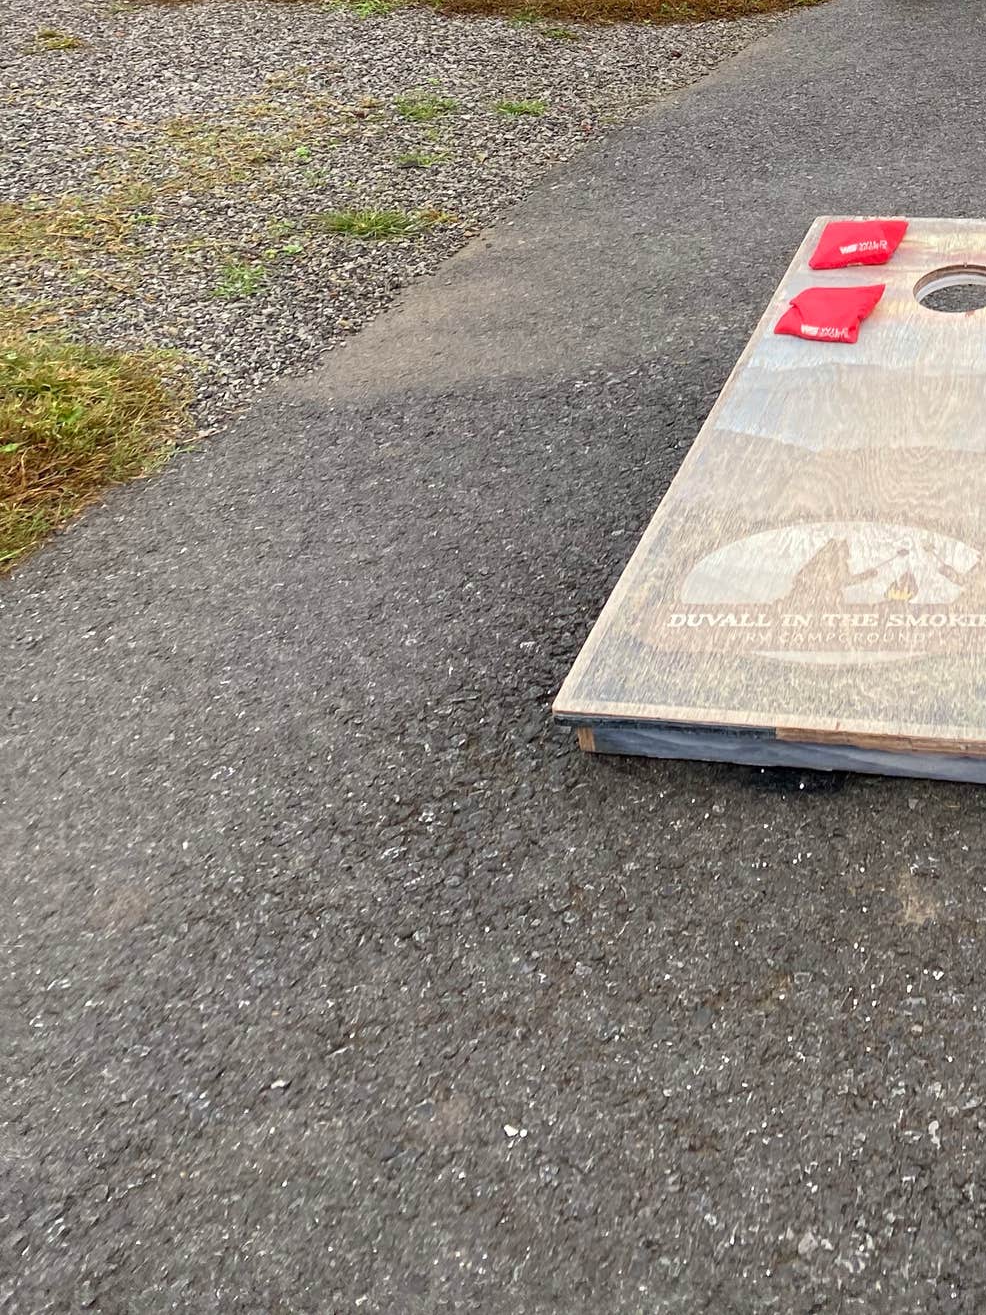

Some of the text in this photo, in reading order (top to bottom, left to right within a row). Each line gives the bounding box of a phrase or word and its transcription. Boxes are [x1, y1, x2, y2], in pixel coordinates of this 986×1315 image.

[667, 613, 771, 628] DUVALL
[782, 613, 812, 628] IN
[823, 613, 879, 628] THE
[779, 632, 925, 643] CAMPGROUND
